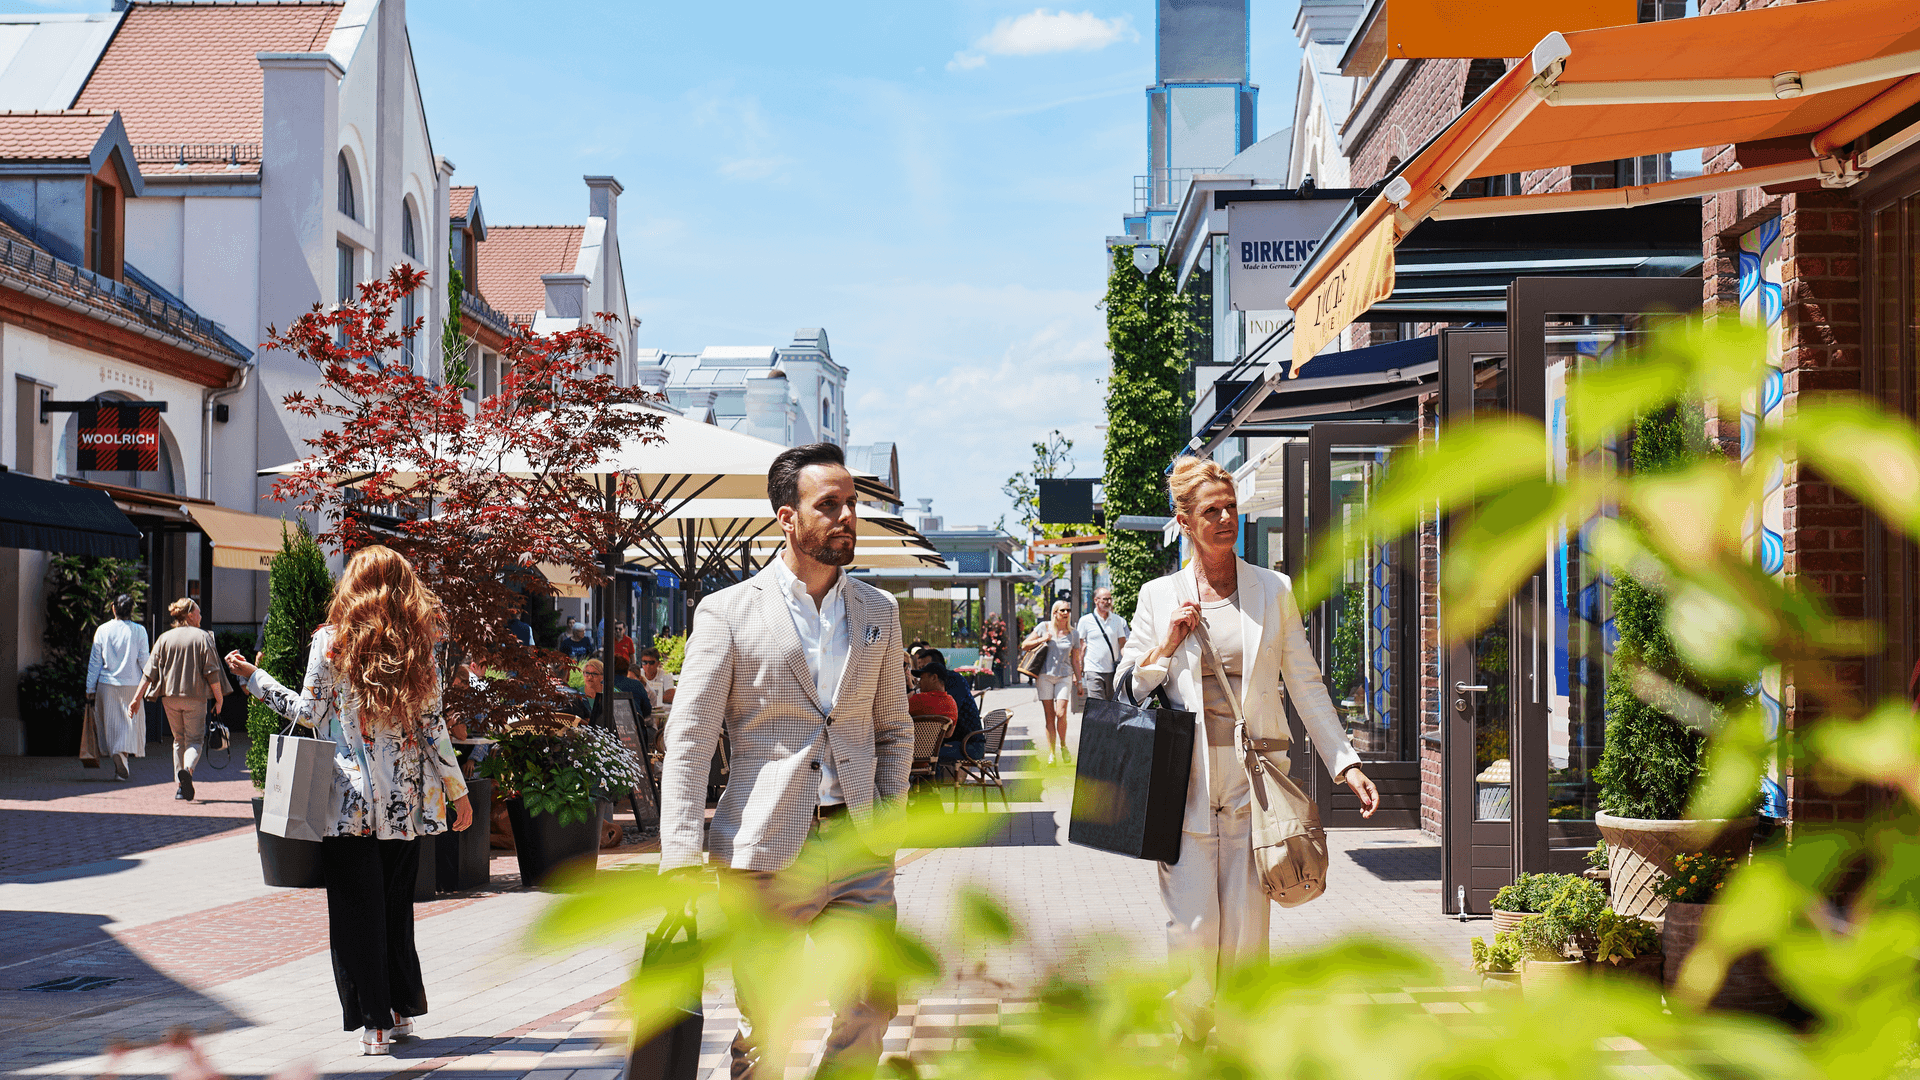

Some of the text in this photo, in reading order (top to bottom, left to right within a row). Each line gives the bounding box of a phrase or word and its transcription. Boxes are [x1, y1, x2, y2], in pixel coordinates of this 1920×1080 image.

[1241, 240, 1320, 262] BIRKENS
[1269, 262, 1298, 270] Germany
[82, 433, 155, 445] WOOLRICH
